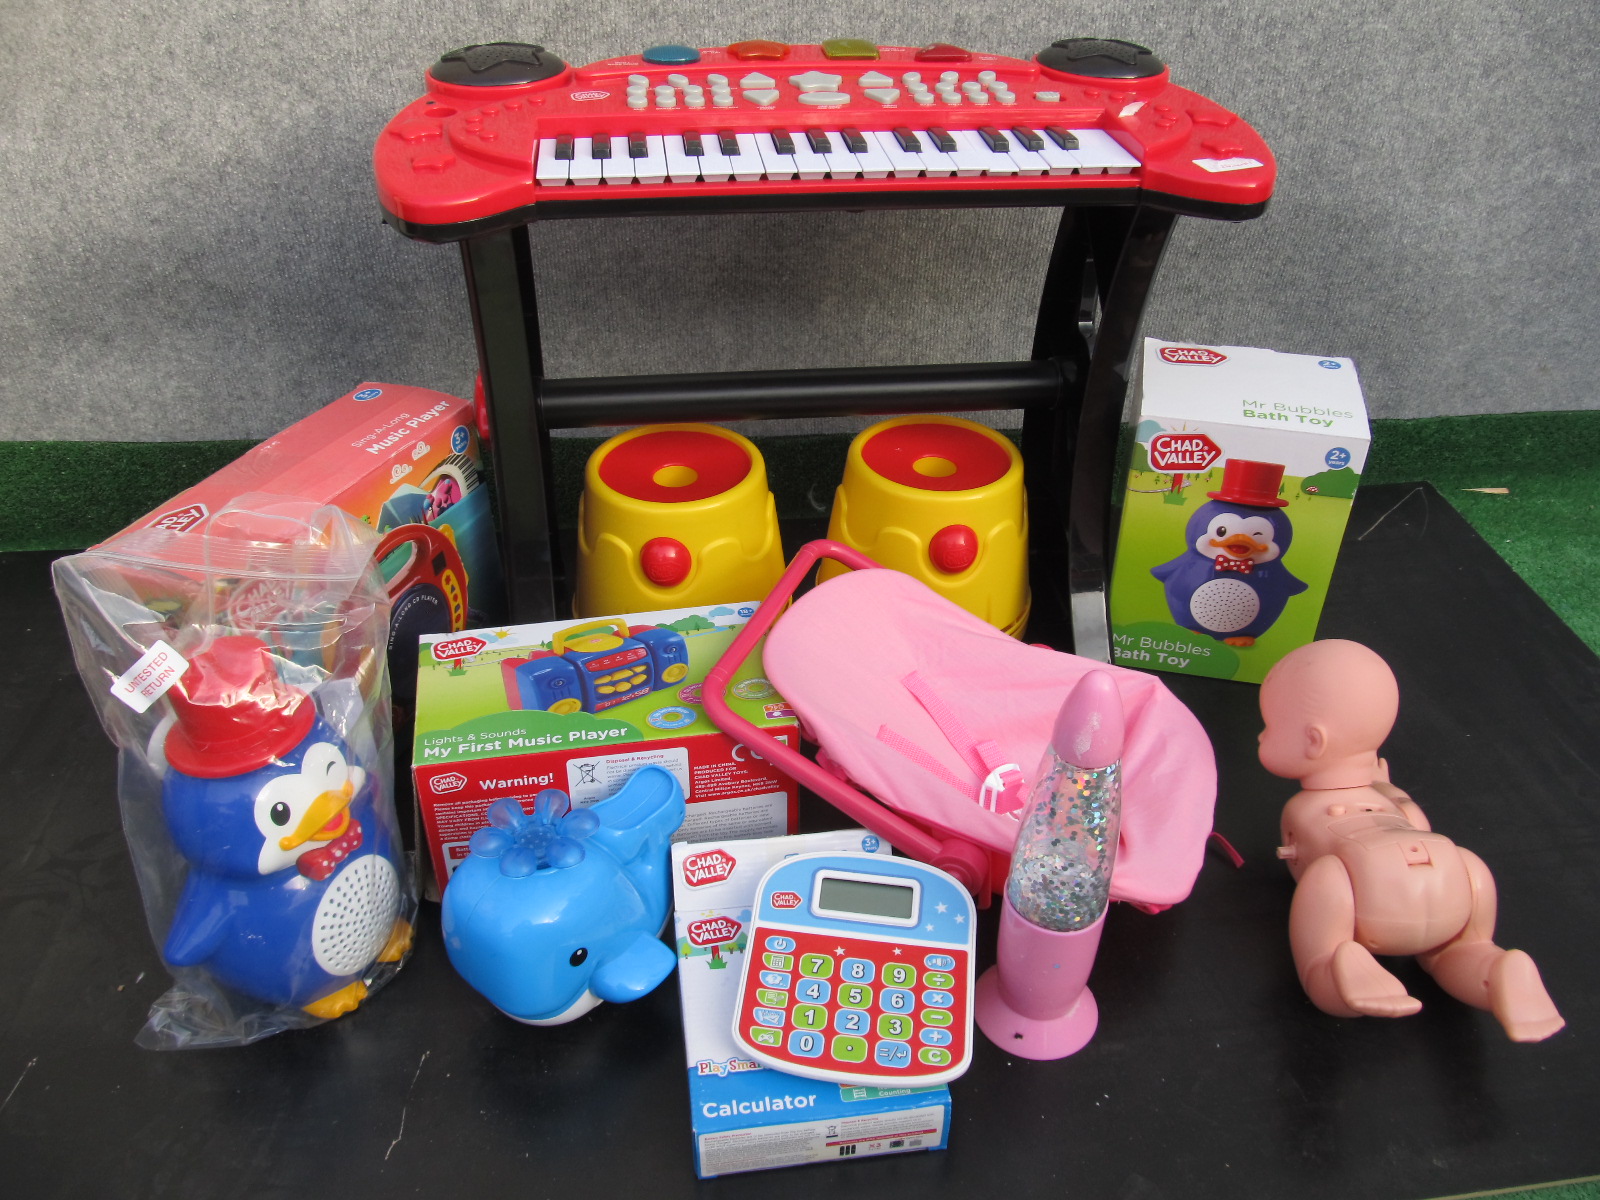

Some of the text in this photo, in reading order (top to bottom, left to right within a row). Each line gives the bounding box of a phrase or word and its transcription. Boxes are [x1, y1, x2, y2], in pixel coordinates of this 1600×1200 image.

[1164, 354, 1222, 363] VALLEY
[1242, 400, 1353, 418] Mr Bubbles
[1243, 409, 1334, 428] Bath Toy
[352, 412, 410, 448] Sing-A-Long
[366, 401, 451, 455] Music Player
[454, 432, 465, 444] 3+
[1156, 437, 1204, 452] CHAD
[1154, 451, 1216, 466] VALLEY
[1330, 450, 1346, 460] 2+
[436, 642, 482, 658] VALLEY
[437, 640, 472, 651] CHAD
[1112, 633, 1211, 656] Mr Bubbles
[1156, 652, 1190, 668] Toy
[124, 652, 168, 693] UNTESTED
[141, 666, 175, 697] RETURN
[424, 735, 463, 745] Lights
[480, 728, 526, 739] Sounds
[424, 728, 628, 758] My First Music Player
[434, 776, 456, 785] CHAD
[434, 779, 462, 791] VALLEY
[479, 773, 554, 790] Warning!
[865, 838, 876, 846] 3+
[686, 854, 722, 870] CHAD
[686, 861, 732, 883] VALLEY
[691, 920, 727, 933] CHAD
[691, 925, 738, 943] VALLEY
[811, 958, 824, 973] 7
[851, 964, 865, 978] 8
[893, 968, 907, 983] 9
[806, 984, 820, 999] 4
[849, 988, 862, 1004] 5
[891, 993, 905, 1009] 6
[804, 1010, 815, 1025] 1
[845, 1014, 860, 1030] 2
[888, 1019, 902, 1035] 3
[800, 1035, 814, 1052] 0
[928, 1050, 942, 1062] C
[879, 1089, 911, 1097] Counting
[702, 1095, 817, 1118] Calculator
